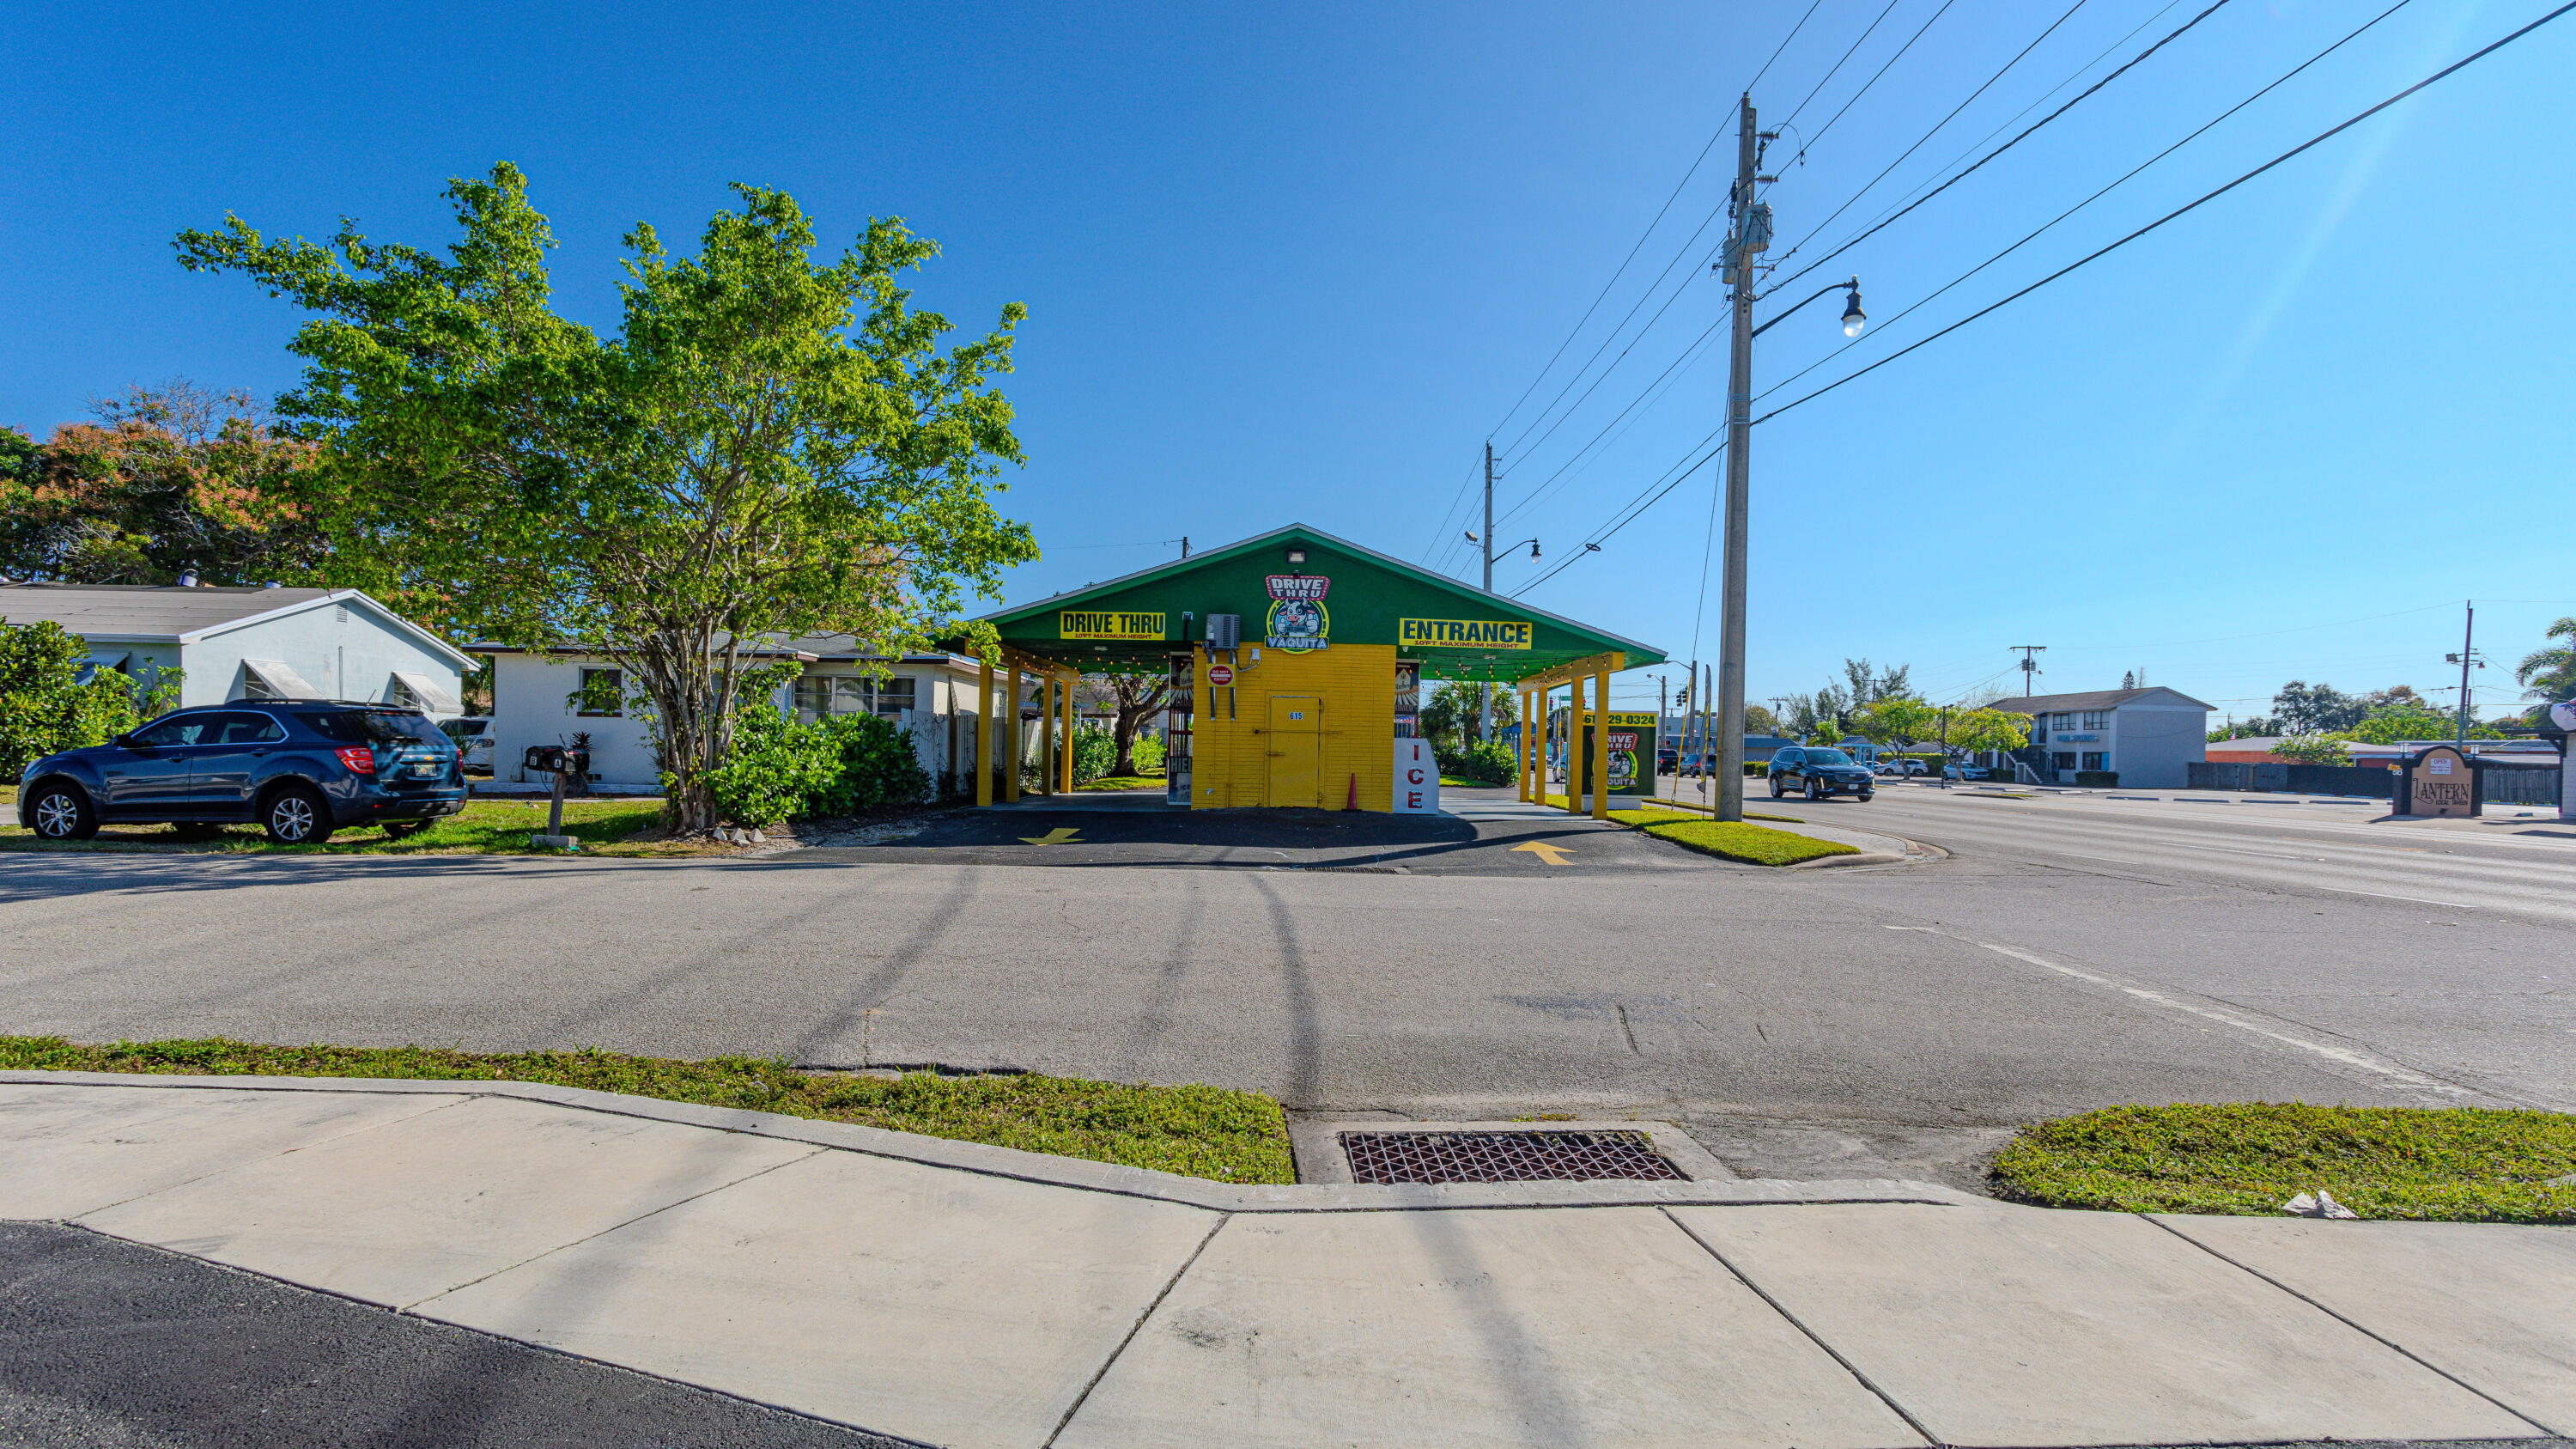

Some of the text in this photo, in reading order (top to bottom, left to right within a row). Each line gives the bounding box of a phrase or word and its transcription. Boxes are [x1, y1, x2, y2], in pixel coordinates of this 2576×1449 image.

[1271, 578, 1323, 590] DRIVE
[1063, 613, 1164, 634] DRIVE THRU
[1403, 619, 1528, 643] ENTRANCE
[1267, 637, 1327, 649] VAQUITA
[1607, 734, 1633, 743] RIVE
[1170, 757, 1192, 773] HIEL
[1407, 744, 1425, 809] ICE
[2412, 777, 2470, 805] LANTERN
